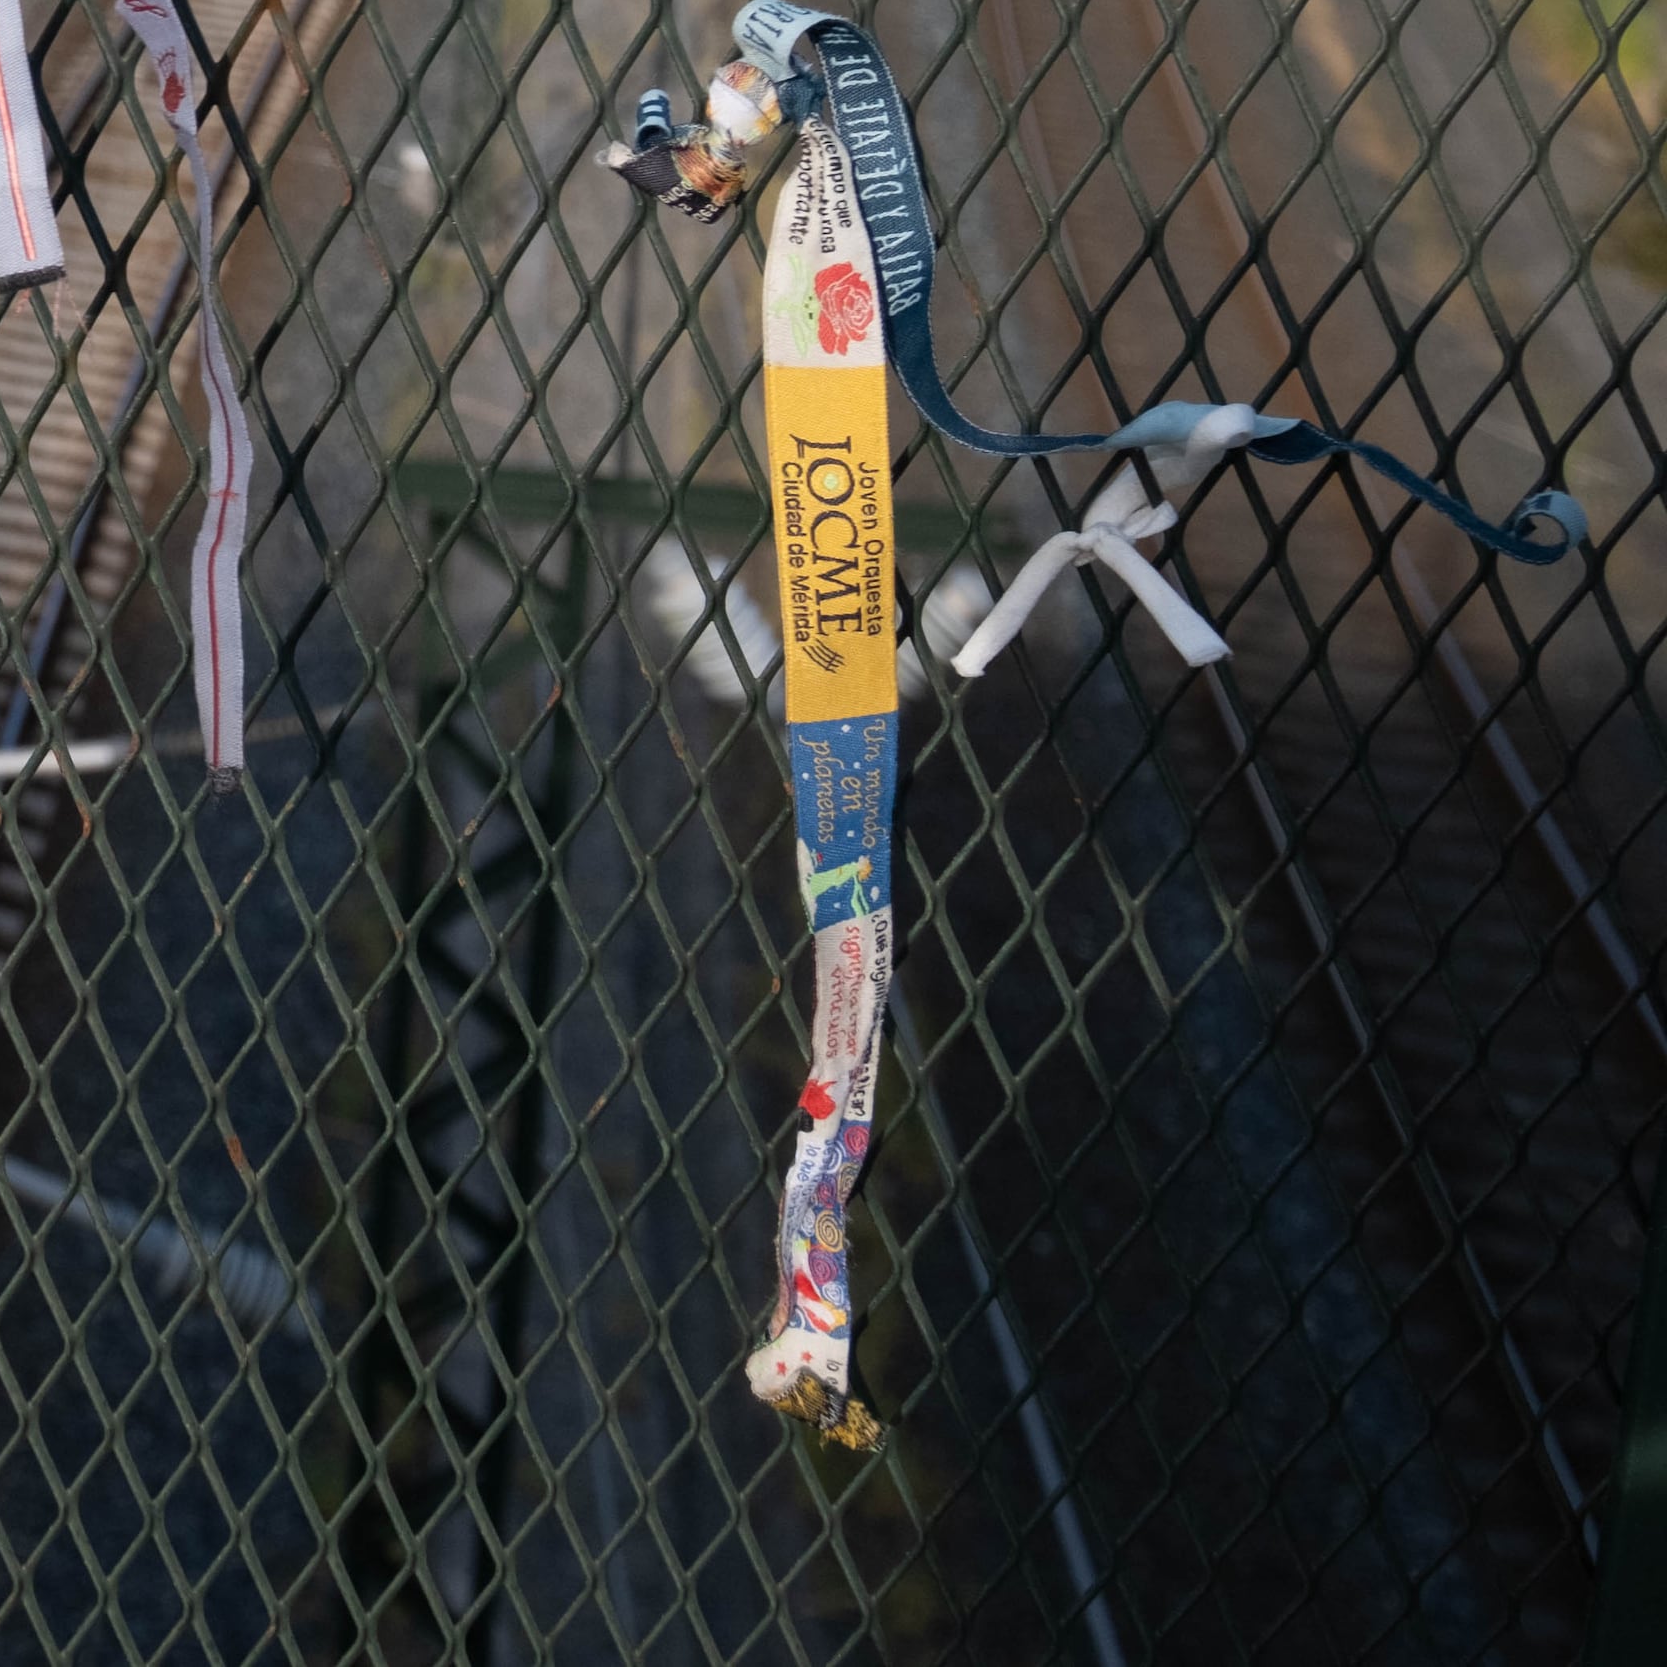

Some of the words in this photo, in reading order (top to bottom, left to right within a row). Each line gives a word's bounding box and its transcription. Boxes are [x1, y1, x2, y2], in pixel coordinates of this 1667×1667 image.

[833, 199, 854, 230] que
[782, 461, 808, 537] Ciudad
[858, 461, 881, 531] Joven
[787, 543, 809, 569] de
[789, 433, 864, 637] JOCME
[790, 574, 814, 644] Mérida
[861, 539, 885, 637] Orquesta
[862, 718, 887, 762] Un
[798, 734, 845, 845] planetas
[840, 776, 863, 814] en
[861, 768, 887, 849] mundo
